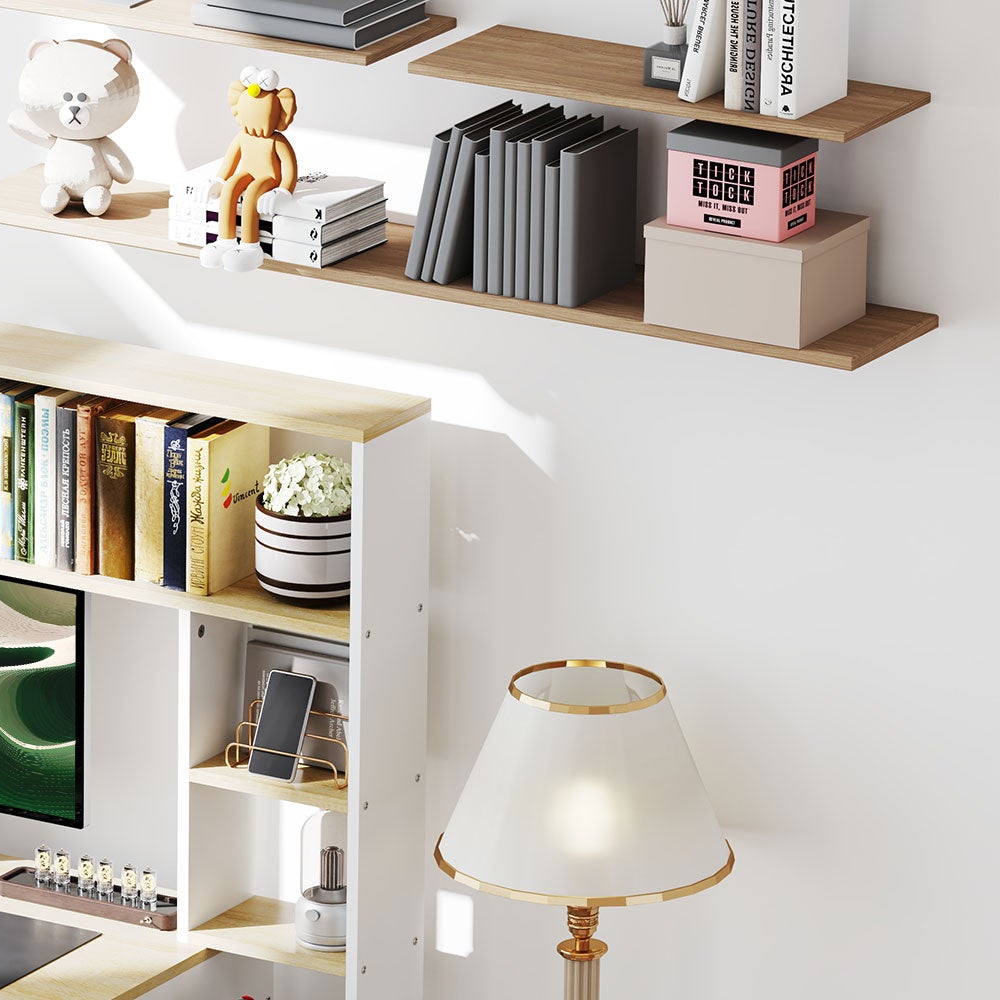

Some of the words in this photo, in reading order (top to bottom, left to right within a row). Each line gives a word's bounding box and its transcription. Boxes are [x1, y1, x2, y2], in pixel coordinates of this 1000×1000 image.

[697, 162, 750, 184] TICK
[784, 161, 813, 185] TICK
[697, 181, 750, 202] TOCK
[784, 180, 813, 204] TOCK
[698, 200, 712, 209] MISS
[722, 204, 736, 213] MISS
[738, 206, 748, 214] OUT
[41, 408, 50, 452] ПОЭМЫ
[62, 428, 70, 477] КРЕПОСТЬ
[62, 478, 70, 517] ЛЕСНАЯ
